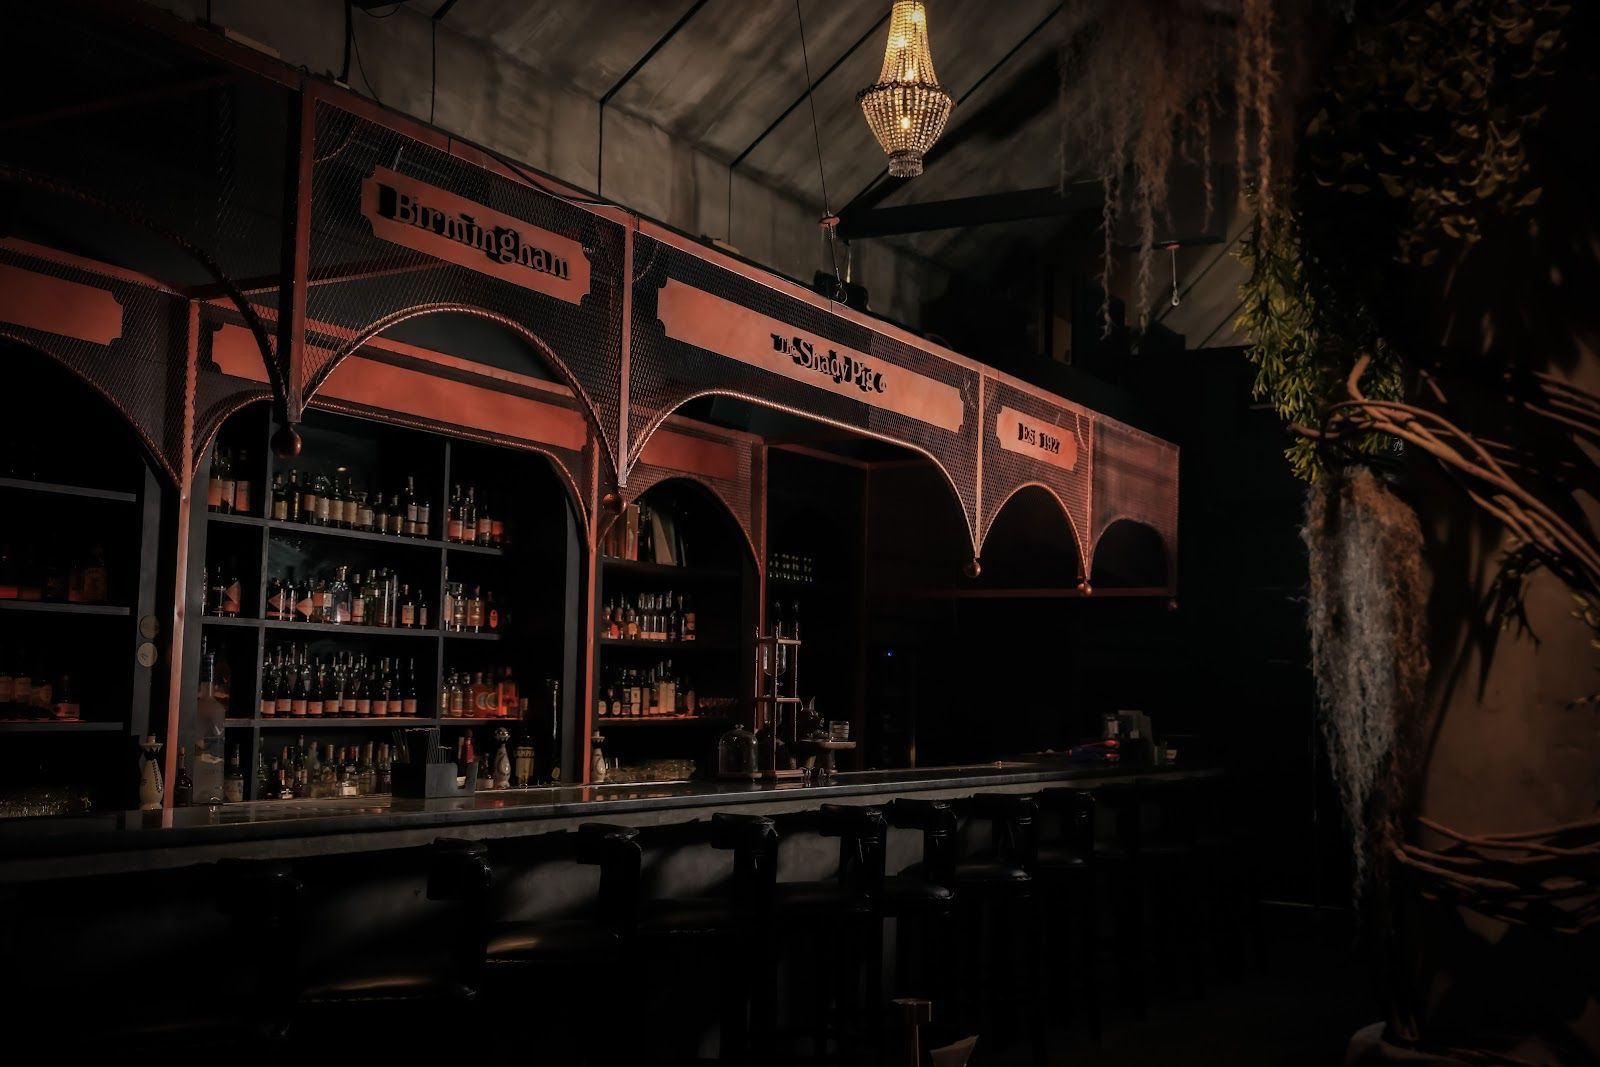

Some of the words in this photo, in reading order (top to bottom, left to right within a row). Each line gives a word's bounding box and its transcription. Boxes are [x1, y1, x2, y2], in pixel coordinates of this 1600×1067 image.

[381, 187, 571, 280] Birmingham
[772, 334, 799, 358] The
[798, 338, 850, 383] Shady
[849, 358, 875, 392] Pig
